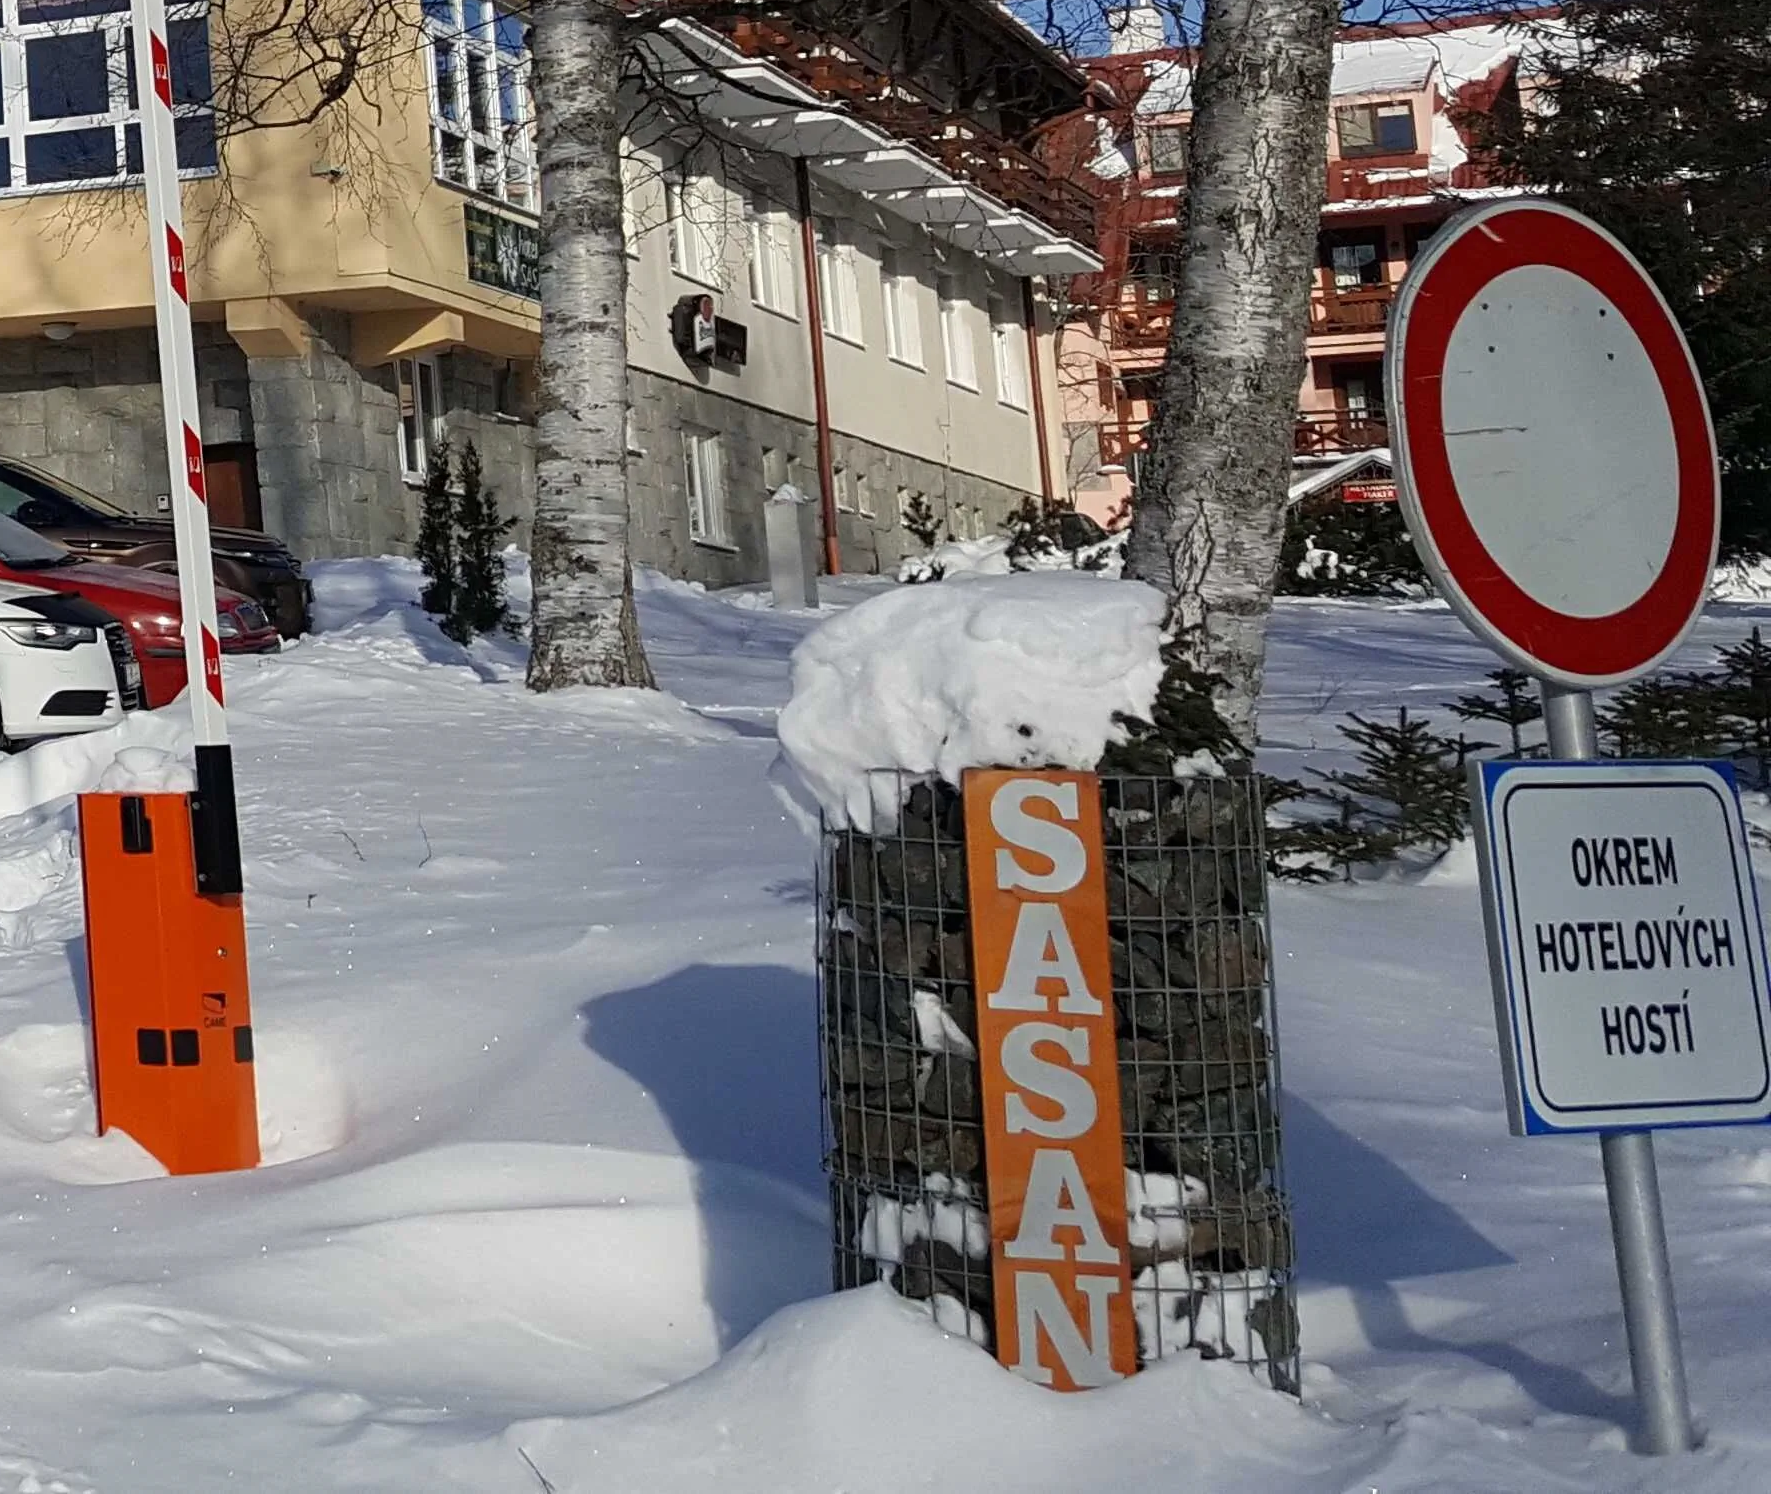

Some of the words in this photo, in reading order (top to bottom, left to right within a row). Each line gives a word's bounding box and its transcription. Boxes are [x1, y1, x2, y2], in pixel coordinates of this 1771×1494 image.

[1571, 837, 1678, 887] OKREM
[1535, 905, 1735, 973] HOTELOVÝCH
[1601, 988, 1694, 1056] HOSTÍ
[988, 777, 1127, 1389] SASAN
